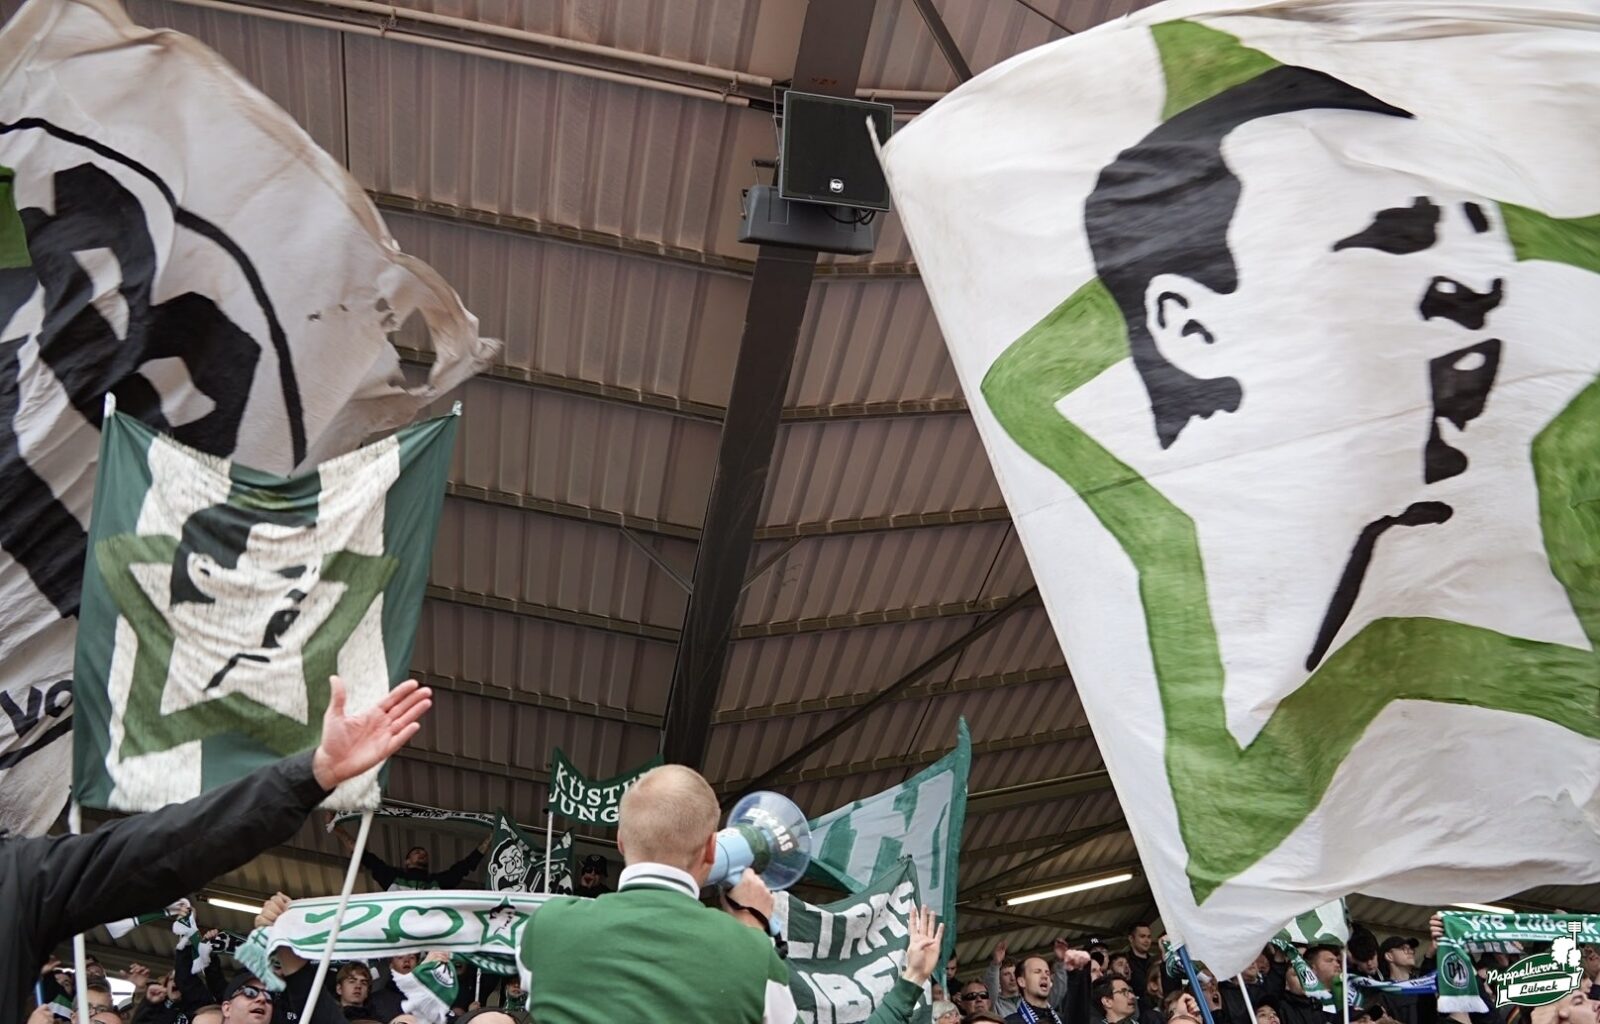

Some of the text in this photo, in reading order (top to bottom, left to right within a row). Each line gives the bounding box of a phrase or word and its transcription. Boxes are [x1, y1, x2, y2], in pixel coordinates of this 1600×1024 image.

[548, 783, 620, 824] JUNG
[556, 761, 648, 806] KÜSTE
[1463, 913, 1599, 935] VfB Lübek
